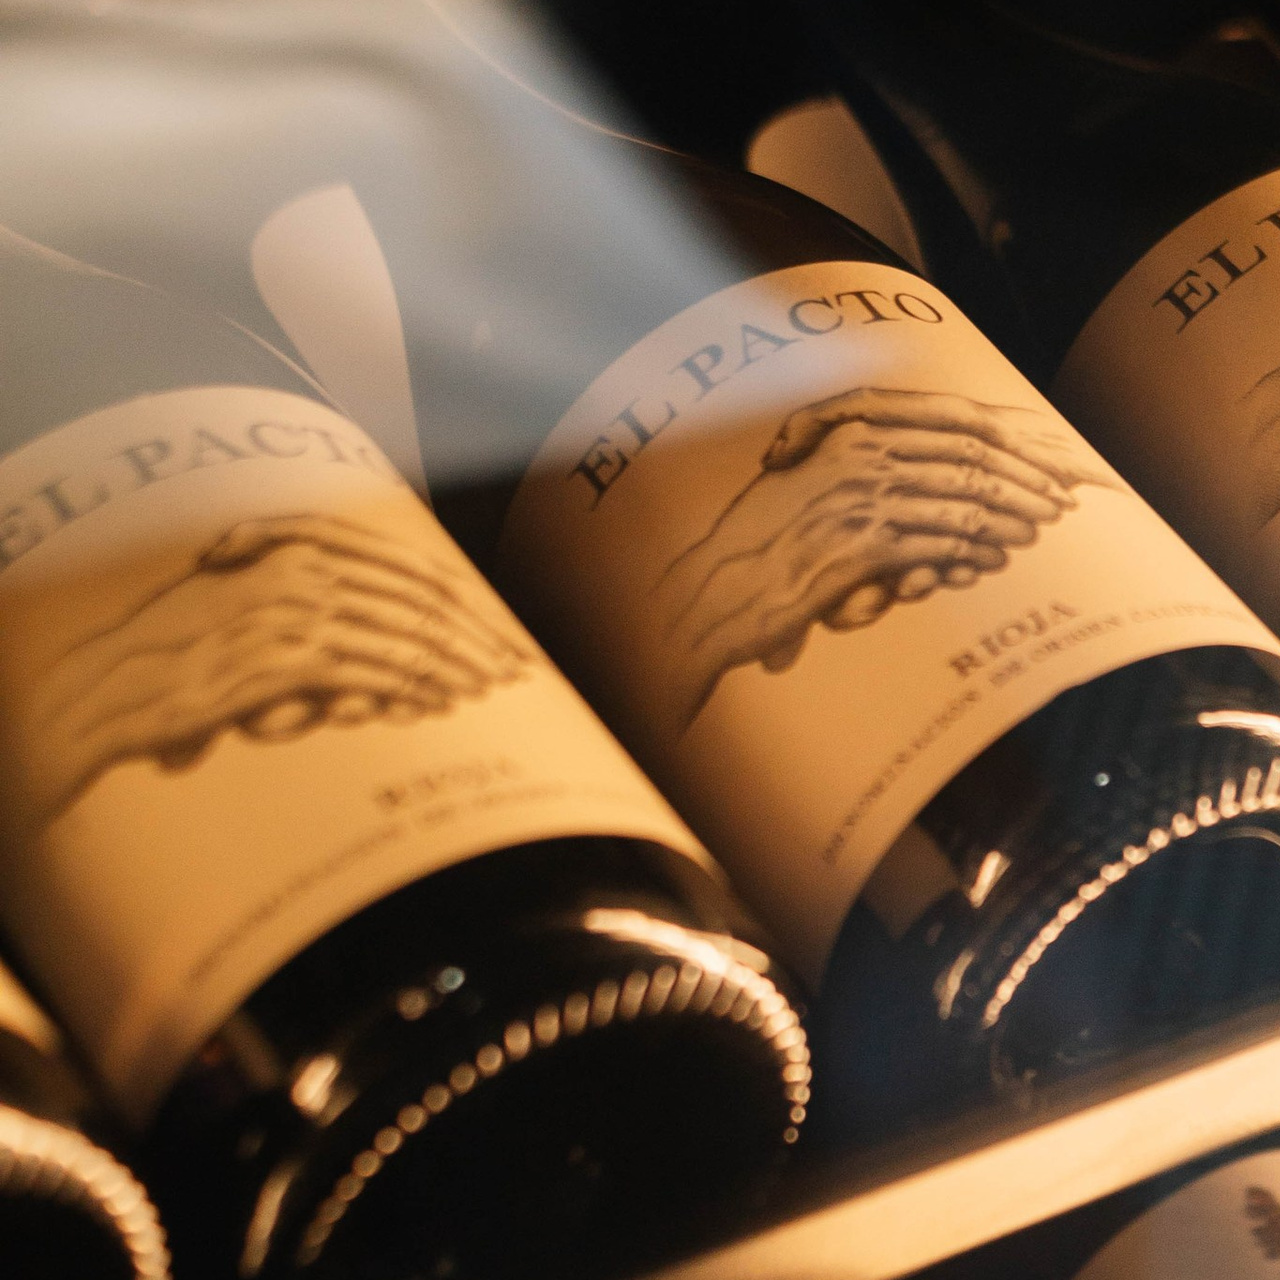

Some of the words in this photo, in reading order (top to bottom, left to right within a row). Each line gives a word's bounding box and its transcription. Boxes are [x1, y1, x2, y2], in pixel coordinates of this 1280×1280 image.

[1151, 239, 1268, 335] EL
[570, 397, 678, 512] EL
[669, 289, 944, 402] PACTO
[0, 475, 111, 573] EL
